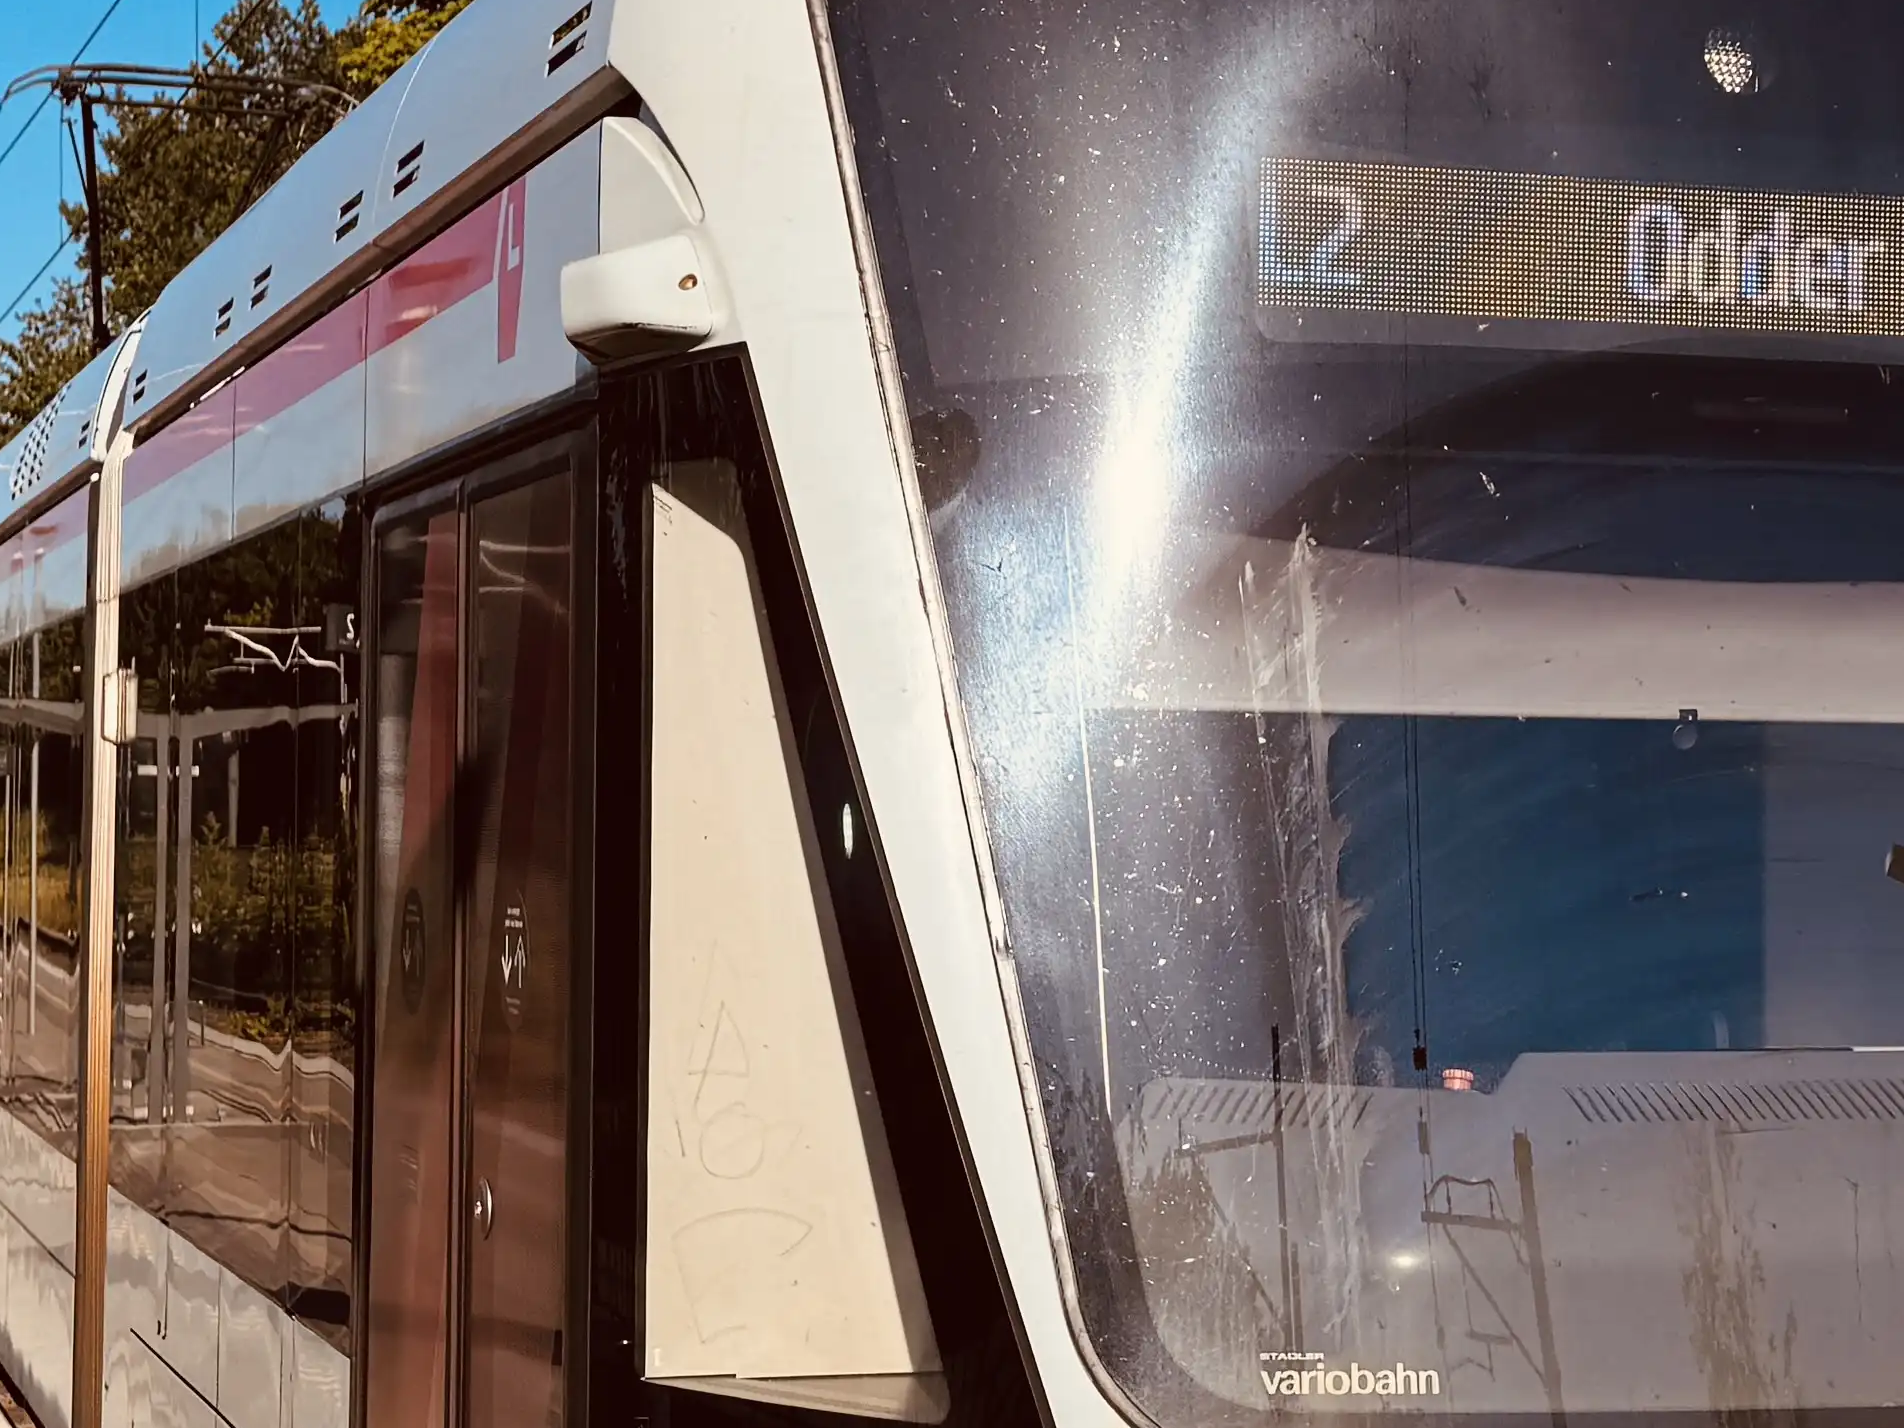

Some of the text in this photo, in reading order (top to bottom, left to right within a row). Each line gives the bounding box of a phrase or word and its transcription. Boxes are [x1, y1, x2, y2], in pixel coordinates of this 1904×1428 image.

[1258, 181, 1886, 310] L2 Odder
[1259, 1352, 1325, 1361] STADLER
[1260, 1362, 1441, 1395] variobahn
